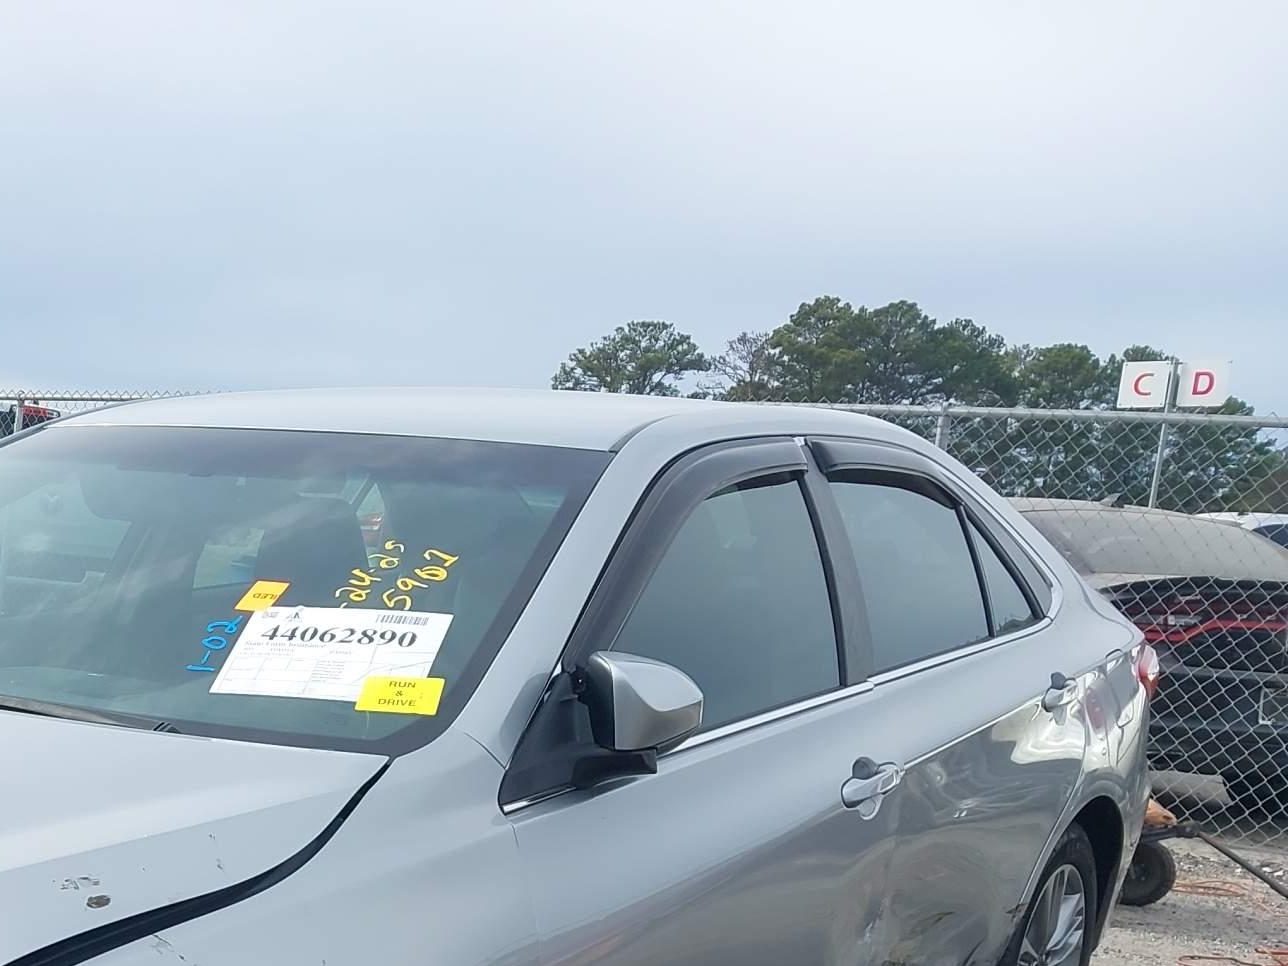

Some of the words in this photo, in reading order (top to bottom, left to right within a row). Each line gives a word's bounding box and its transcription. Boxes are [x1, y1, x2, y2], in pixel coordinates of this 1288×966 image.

[1133, 372, 1155, 396] C
[1191, 371, 1215, 396] D
[260, 623, 418, 648] 44062890
[388, 680, 416, 689] RUN
[378, 698, 417, 707] DRIVE
